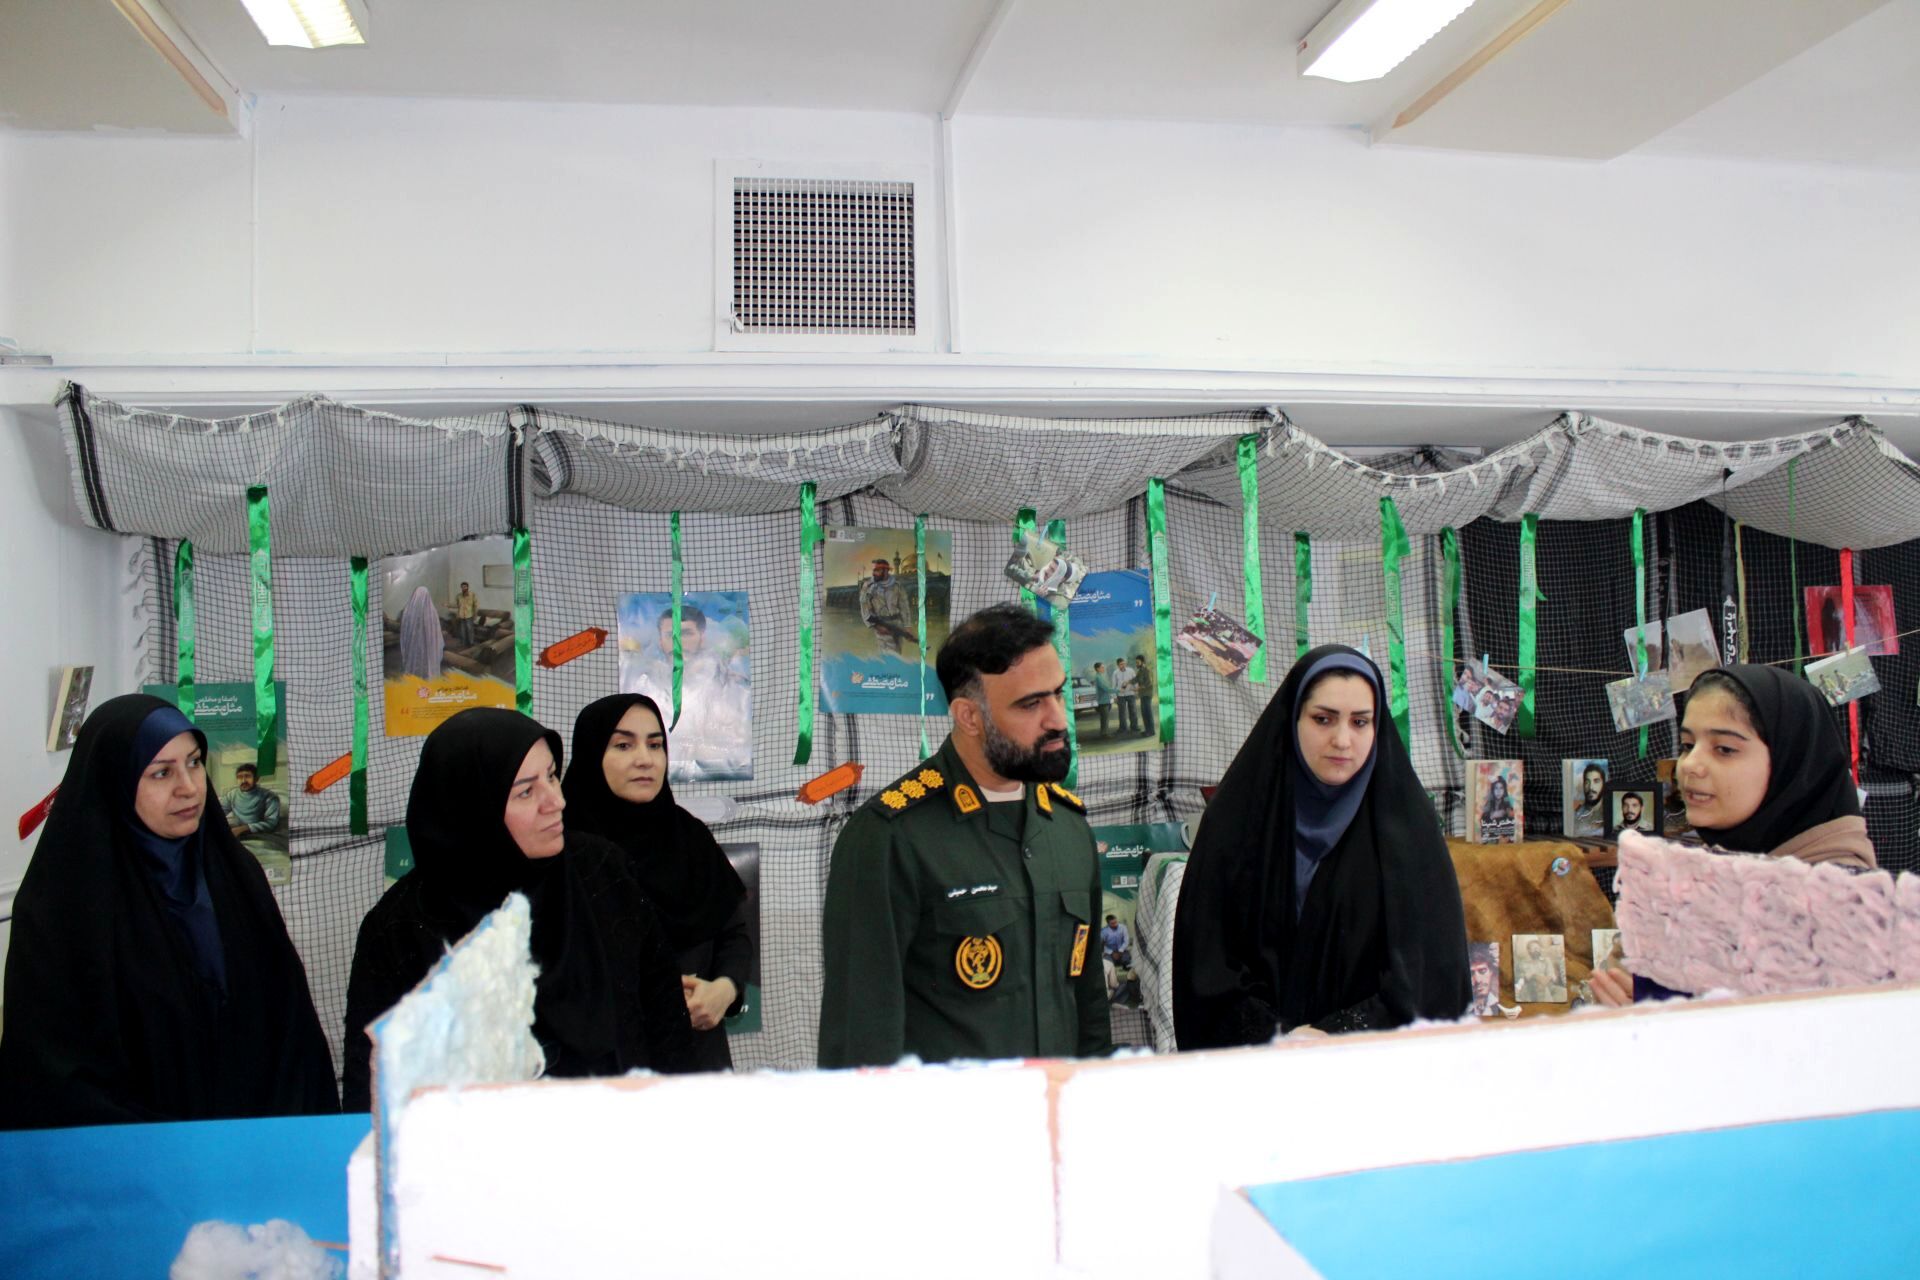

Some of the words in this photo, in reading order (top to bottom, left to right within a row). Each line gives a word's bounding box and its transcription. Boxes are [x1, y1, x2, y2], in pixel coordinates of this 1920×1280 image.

[1071, 592, 1099, 604] مصط
[1726, 621, 1737, 657] مهدی
[861, 676, 896, 689] مصطفی
[887, 676, 909, 690] مثل
[219, 702, 243, 717] مثل
